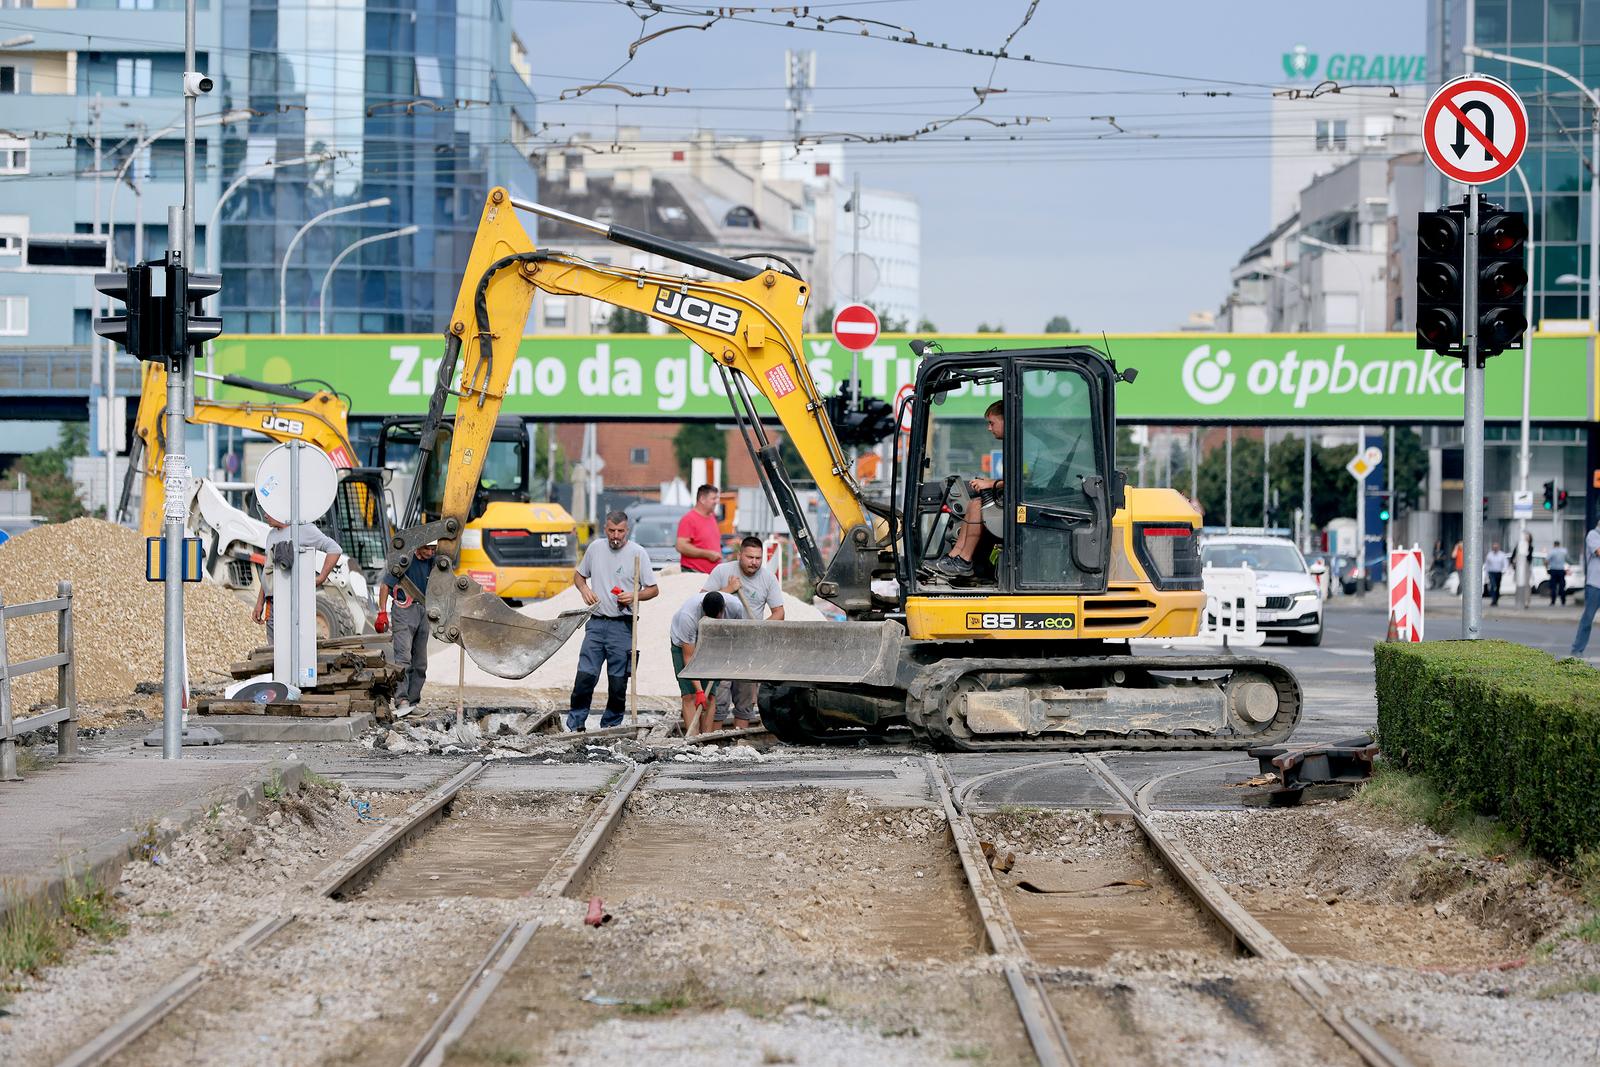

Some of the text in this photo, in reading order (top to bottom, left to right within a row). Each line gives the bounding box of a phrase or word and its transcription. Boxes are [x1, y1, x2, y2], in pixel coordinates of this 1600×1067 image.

[655, 292, 739, 333] JCB
[577, 344, 643, 396] da
[1246, 344, 1466, 408] otpbanka
[262, 415, 304, 436] JCB
[541, 533, 568, 548] JCB
[982, 614, 1016, 629] 85
